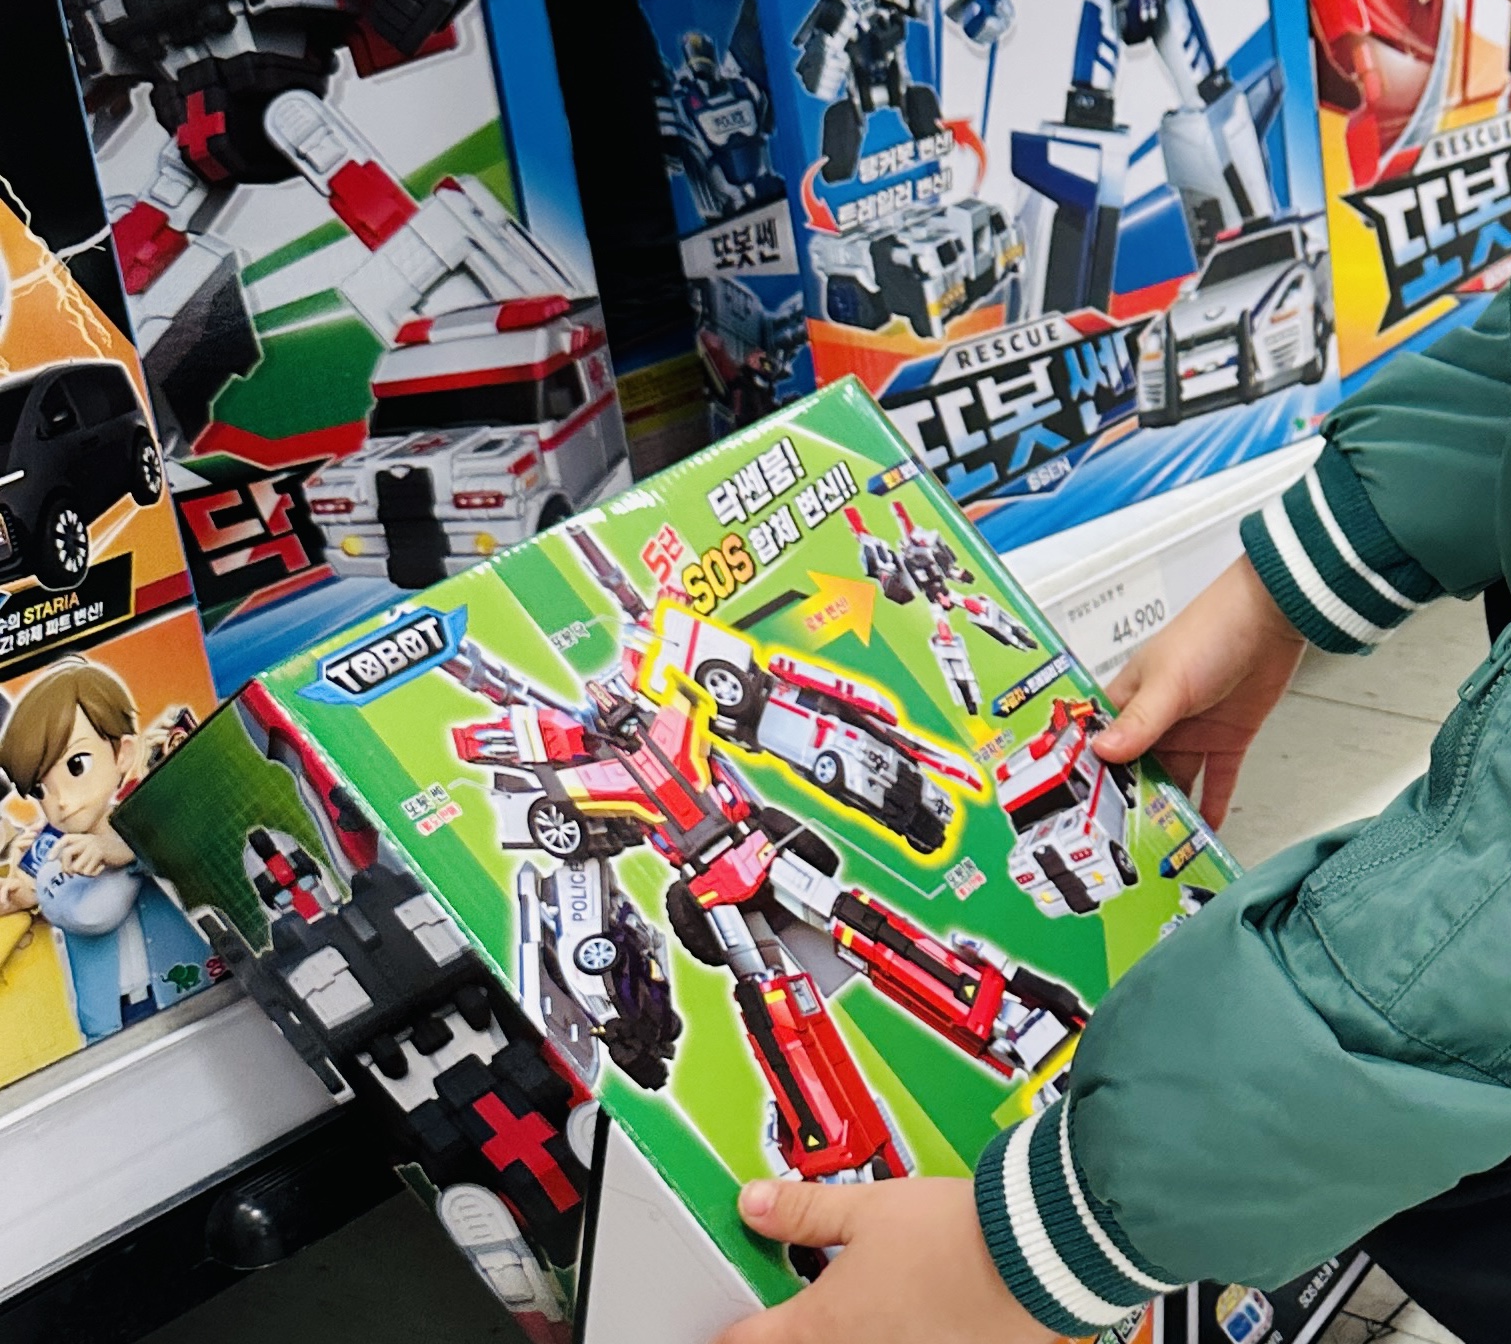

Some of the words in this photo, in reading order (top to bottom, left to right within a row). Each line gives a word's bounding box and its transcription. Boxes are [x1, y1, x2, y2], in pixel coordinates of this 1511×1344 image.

[956, 323, 1060, 369] RESCUE
[1026, 457, 1072, 492] SSEN
[179, 471, 312, 577] 닥
[682, 532, 756, 616] SOS
[748, 504, 802, 566] 합체
[794, 460, 859, 529] 변신!!
[640, 523, 684, 585] 5단
[23, 591, 80, 624] STARIA
[74, 601, 104, 627] 변신!
[1113, 598, 1165, 643] 44,900
[327, 616, 444, 693] TOBOT
[570, 861, 587, 922] POLICE
